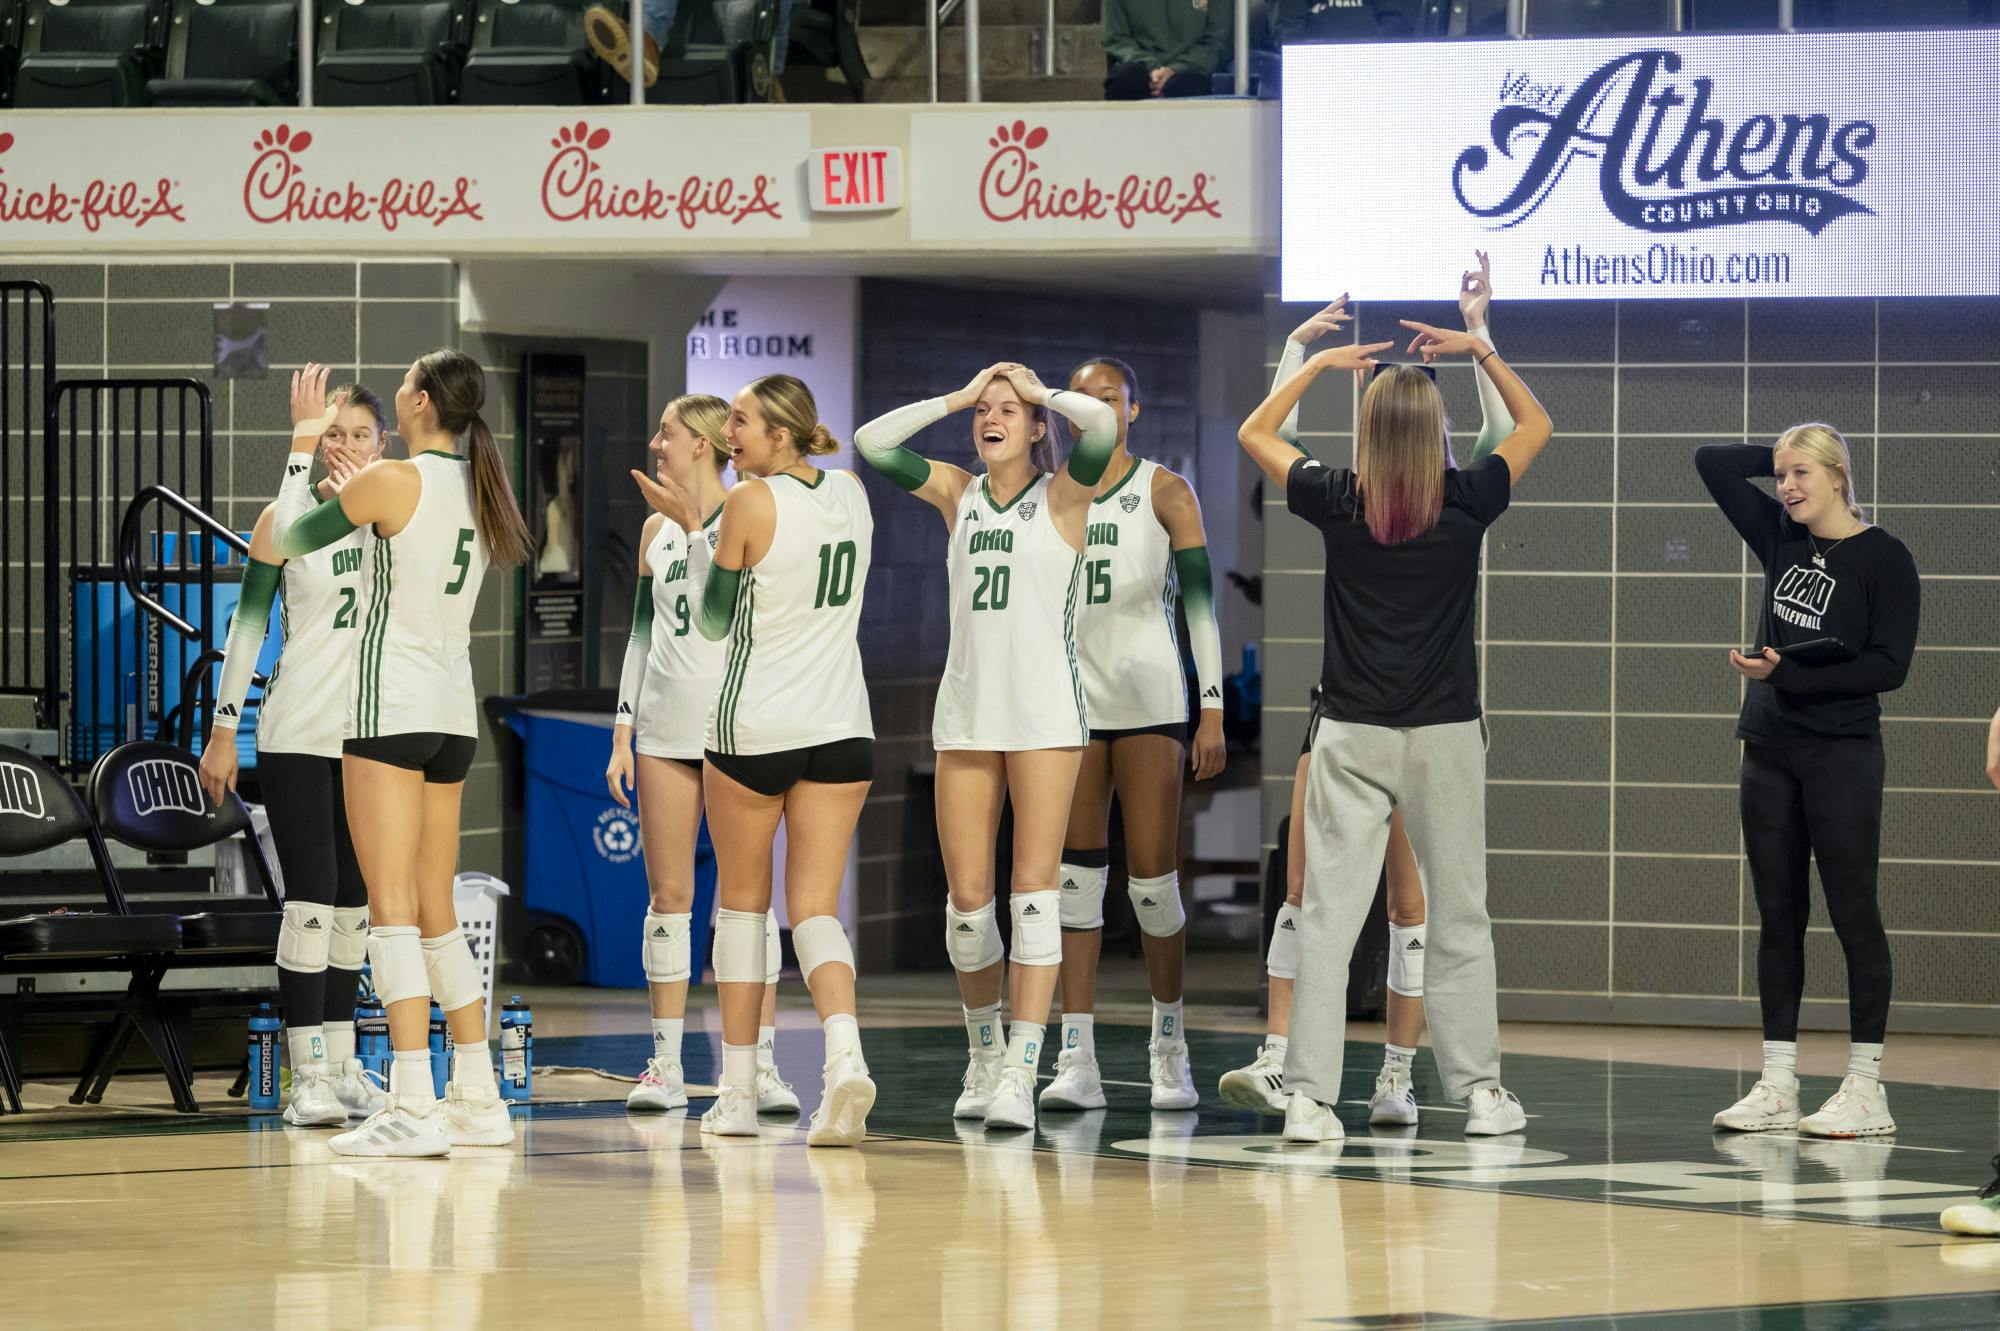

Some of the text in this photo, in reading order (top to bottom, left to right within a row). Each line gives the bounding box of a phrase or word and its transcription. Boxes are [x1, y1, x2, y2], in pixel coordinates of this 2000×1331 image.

[1452, 48, 1877, 228] Athens
[824, 151, 888, 206] EXIT
[0, 178, 186, 232] hick-fil-A
[1640, 191, 1822, 223] COUNTY OHIO
[1541, 242, 1791, 287] AthensOhio.com
[700, 309, 738, 328] HE
[723, 335, 812, 357] ROOM
[969, 528, 1014, 555] OHIO
[1086, 522, 1119, 547] HIO
[332, 547, 363, 576] OHI
[444, 527, 476, 595] 5
[664, 558, 689, 584] OH
[813, 539, 857, 610] 10
[1085, 559, 1112, 605] 15
[972, 565, 1011, 611] 20
[674, 594, 691, 637] 9
[1773, 600, 1821, 631] VOLLEYBALL
[127, 758, 206, 817] OHIO
[262, 1033, 272, 1096] POWERADE
